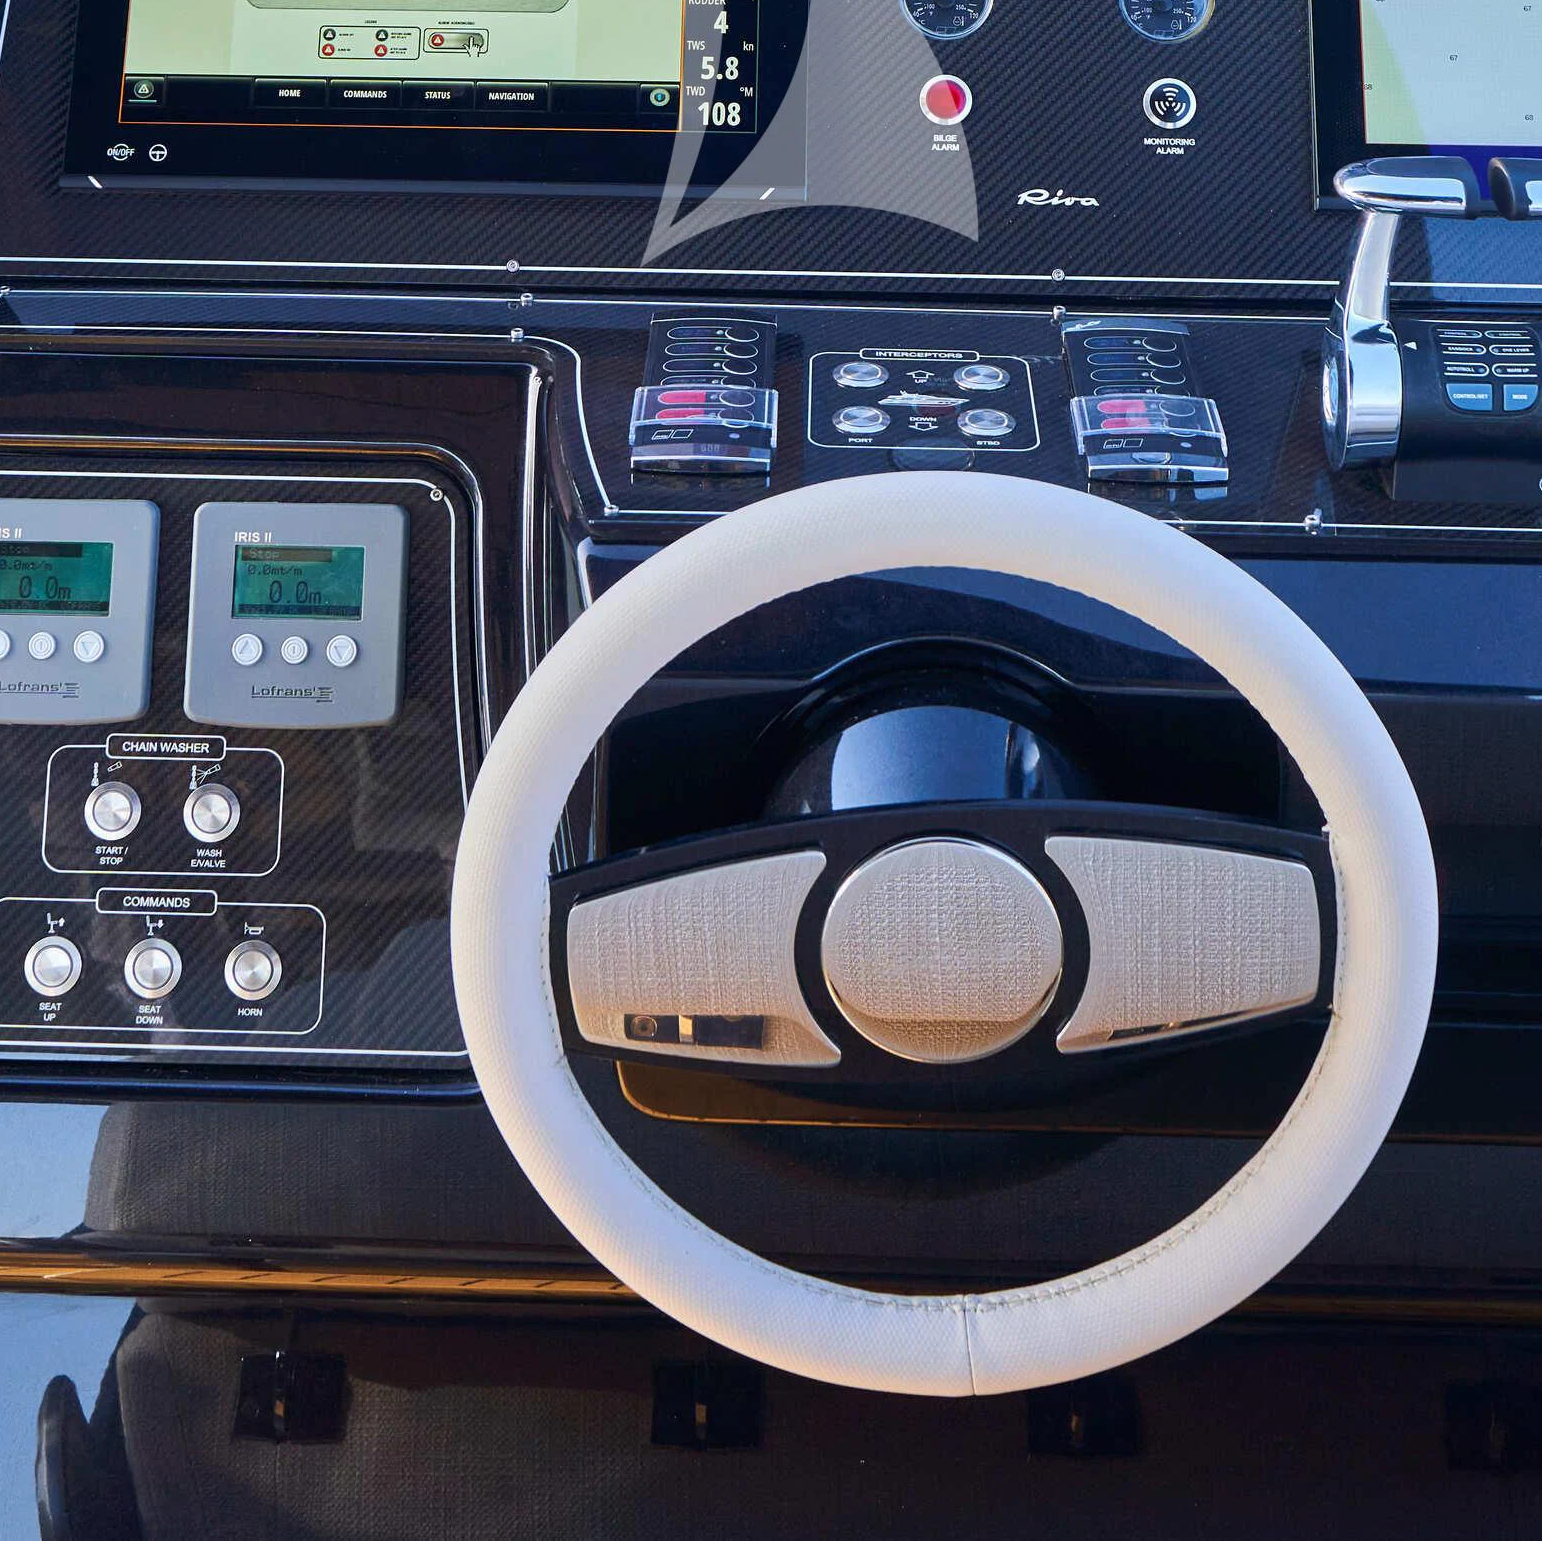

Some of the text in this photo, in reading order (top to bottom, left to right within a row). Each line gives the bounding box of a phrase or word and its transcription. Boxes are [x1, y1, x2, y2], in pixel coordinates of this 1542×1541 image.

[713, 10, 729, 34] 4
[687, 40, 705, 51] TWS
[743, 41, 754, 51] kn
[700, 56, 739, 80] 5.8
[278, 89, 301, 98] HOME
[343, 90, 388, 99] COMMANDS
[425, 91, 451, 100] STATUS
[685, 86, 705, 96] TWD
[488, 92, 535, 101] NAVIGATION
[697, 101, 741, 126] 108
[933, 134, 957, 142] BILGE
[1143, 138, 1196, 146] MONITORING
[931, 143, 960, 151] ALARM
[1156, 146, 1184, 155] ALARM
[107, 147, 135, 157] ON/OFF
[1016, 188, 1100, 207] Riva
[875, 350, 963, 359] INTERCEPTORS
[14, 528, 23, 539] II
[235, 531, 272, 543] IRIS II
[249, 548, 280, 560] Stop
[247, 564, 303, 576] 0.0mt/m
[20, 576, 72, 600] 0.0m
[270, 580, 322, 605] 0.0m
[122, 741, 210, 753] CHAIN WASHER
[95, 846, 123, 855] START
[196, 849, 222, 857] WASH
[99, 856, 124, 865] STOP
[190, 859, 226, 868] E/VALVE
[122, 895, 191, 908] COMMANDS
[38, 1002, 62, 1011] SEAT
[138, 1005, 161, 1014] SEAT
[237, 1008, 263, 1017] HORN
[43, 1013, 56, 1022] UP
[135, 1015, 163, 1025] DOWN
